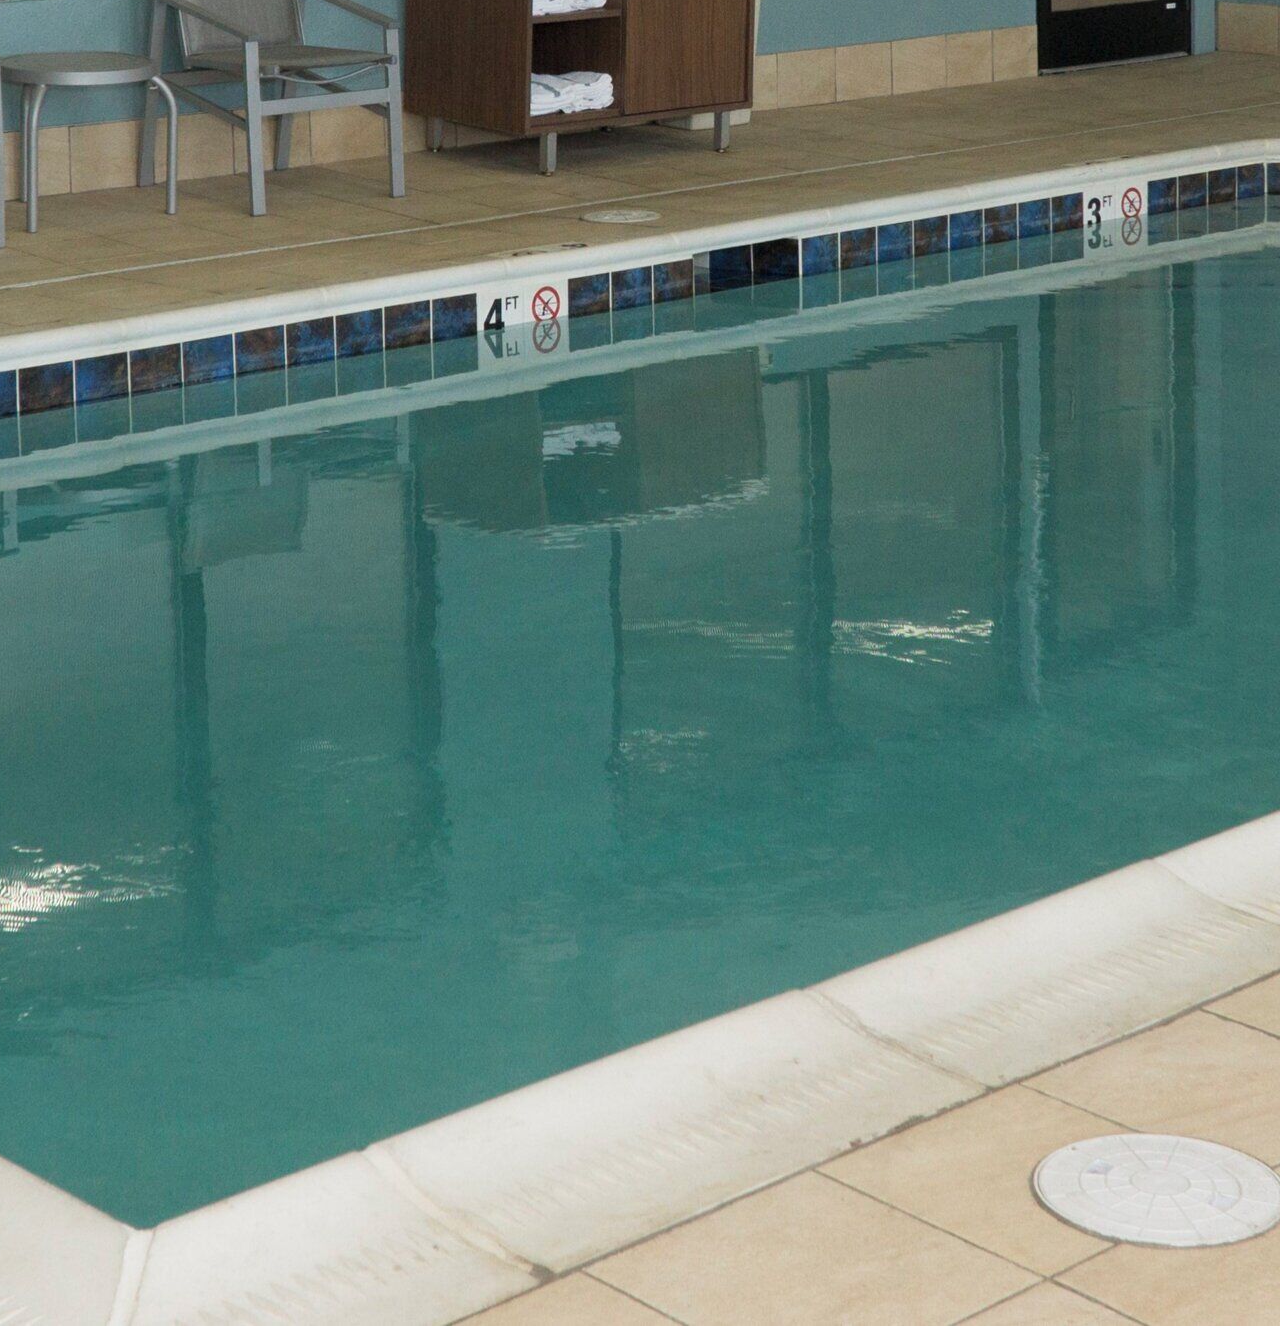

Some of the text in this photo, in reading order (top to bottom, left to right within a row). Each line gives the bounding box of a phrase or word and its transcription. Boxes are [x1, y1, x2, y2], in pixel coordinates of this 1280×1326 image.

[1087, 195, 1113, 227] 3 FT
[483, 295, 519, 331] 4 FT
